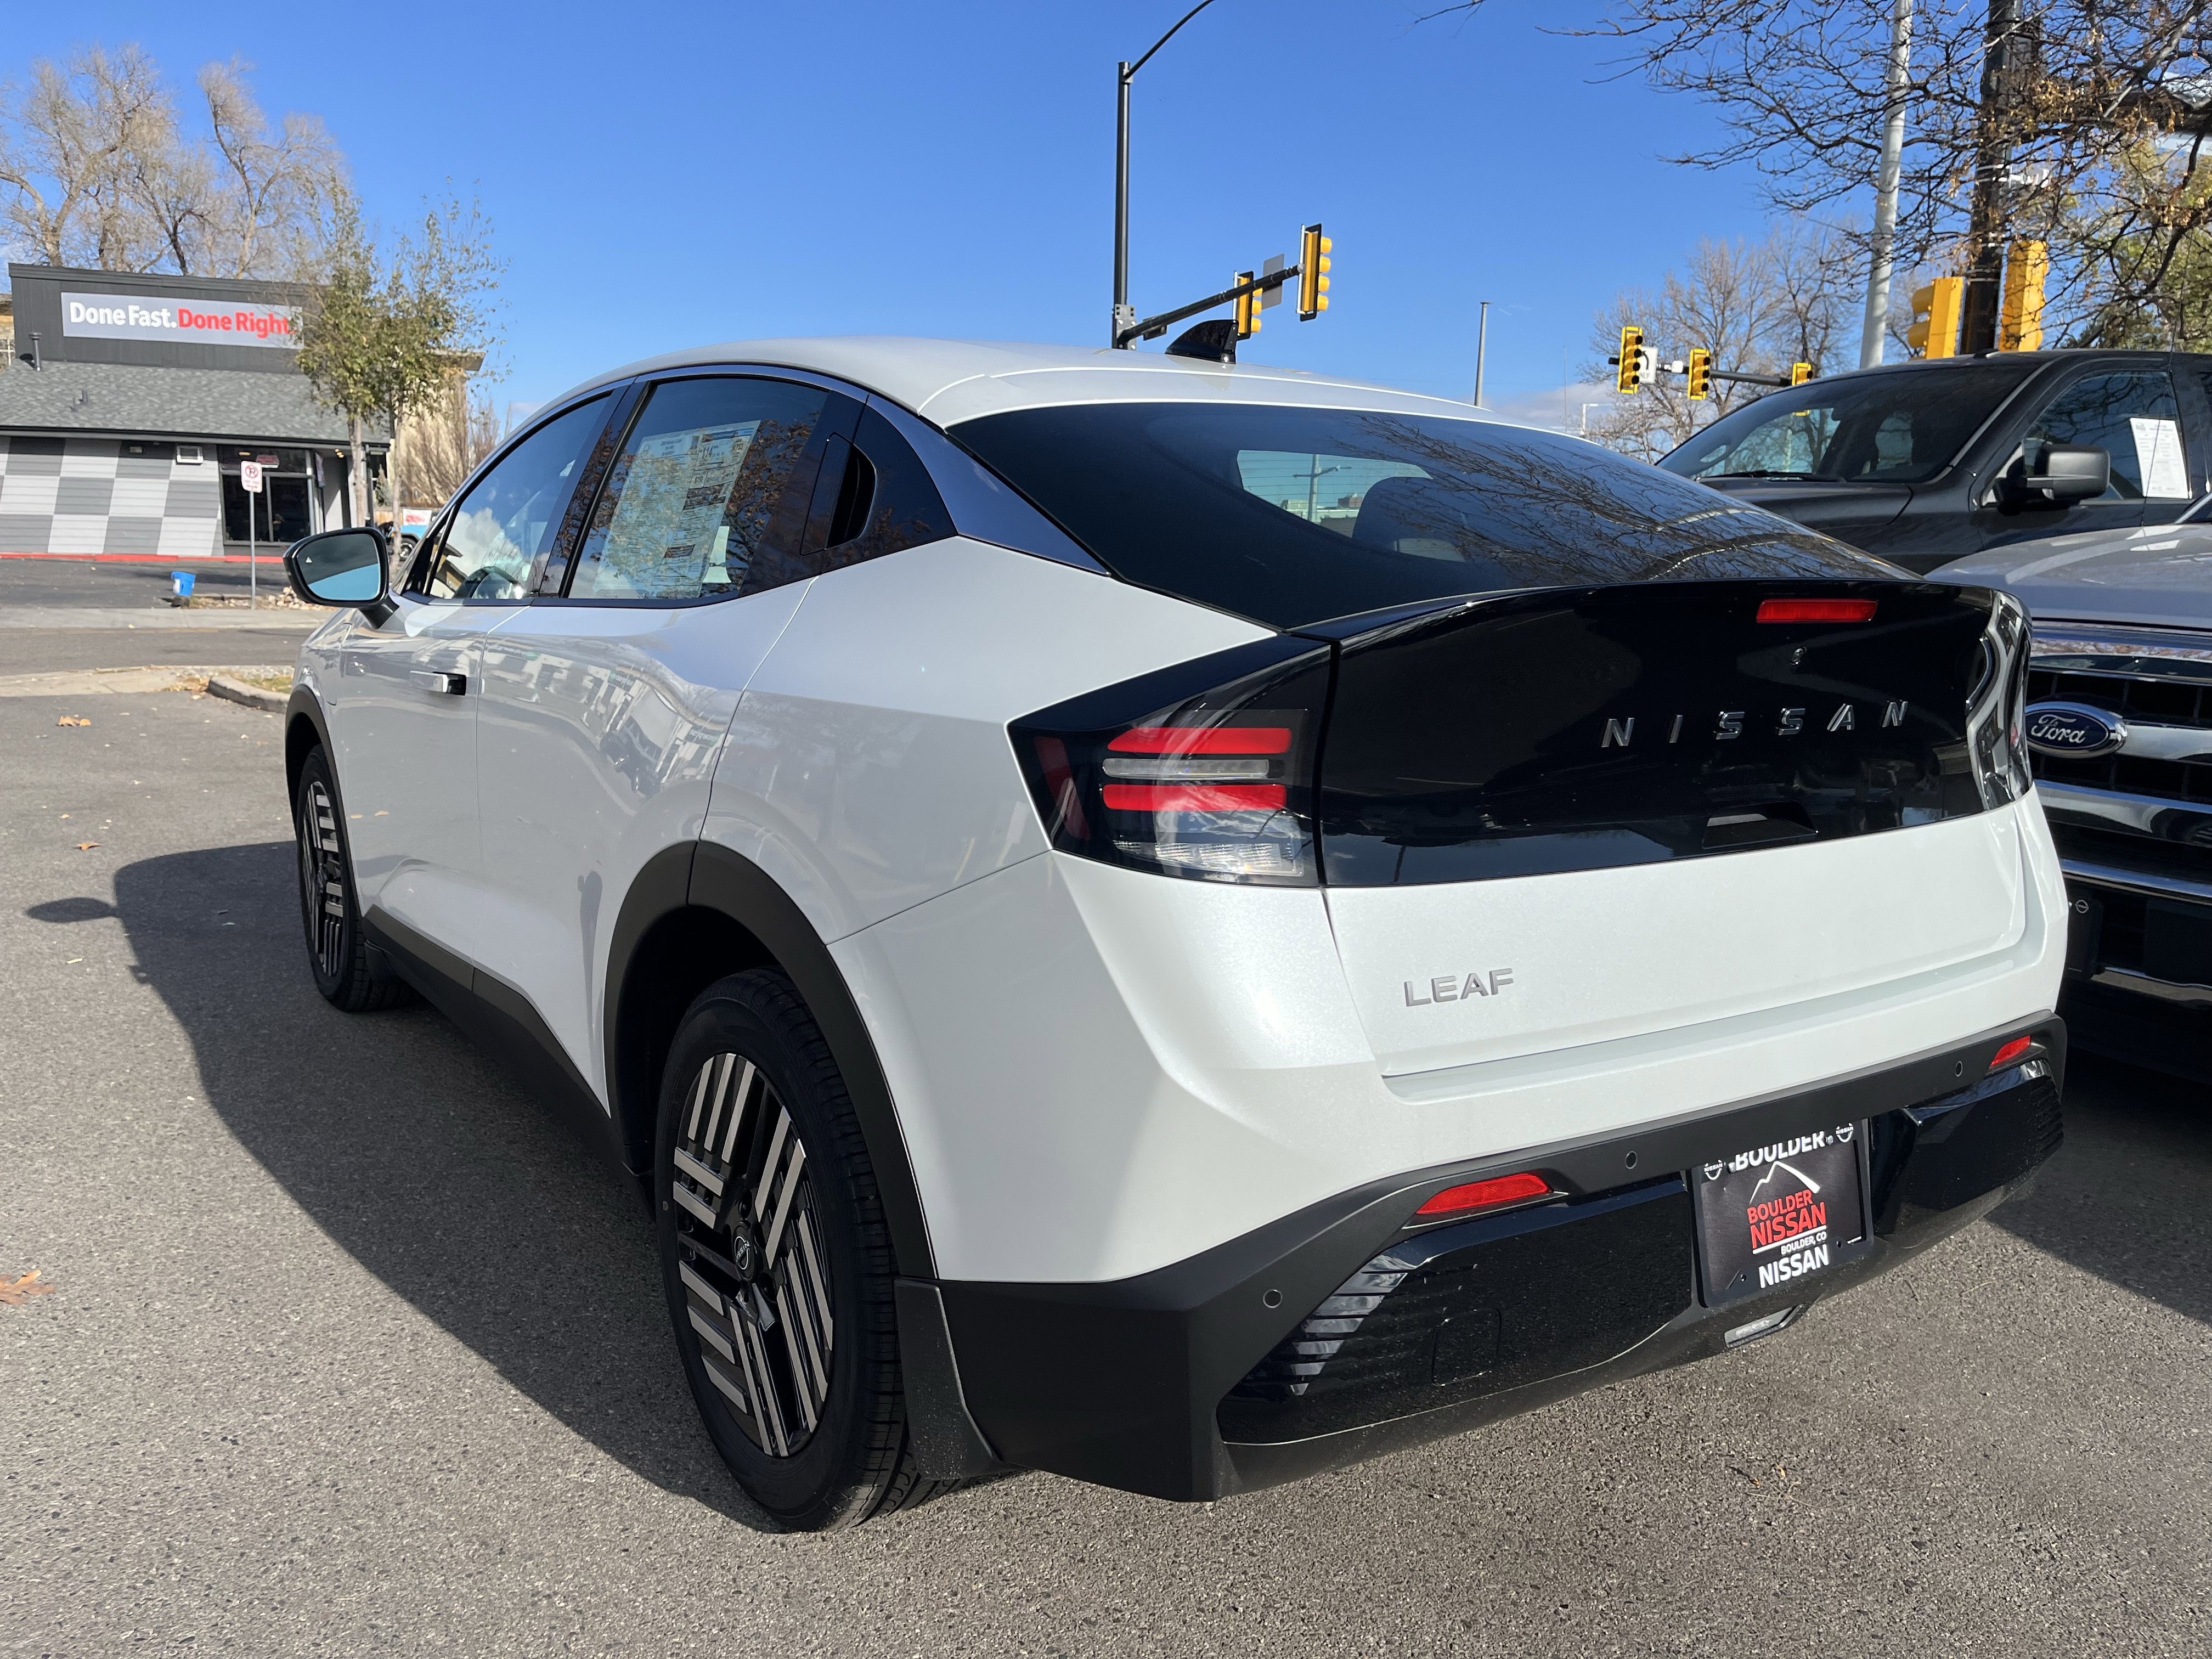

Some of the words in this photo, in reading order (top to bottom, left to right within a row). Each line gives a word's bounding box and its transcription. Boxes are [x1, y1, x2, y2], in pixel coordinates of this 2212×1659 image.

[69, 302, 126, 326] Done
[128, 304, 177, 329] Fast.
[177, 307, 232, 331] Done
[1601, 700, 1908, 748] NISSAN
[2031, 714, 2089, 743] Ford
[1404, 968, 1514, 1007] LEAF
[1836, 1126, 1854, 1135] NISSAN
[1704, 1163, 1723, 1172] NISSAN
[1735, 1131, 1826, 1171] BOULDER
[1747, 1189, 1813, 1224] BOULDER
[1750, 1201, 1826, 1249] NISSAN
[1781, 1235, 1816, 1255] BOULDER,
[1816, 1231, 1827, 1243] CO
[1759, 1244, 1829, 1289] NISSAN
